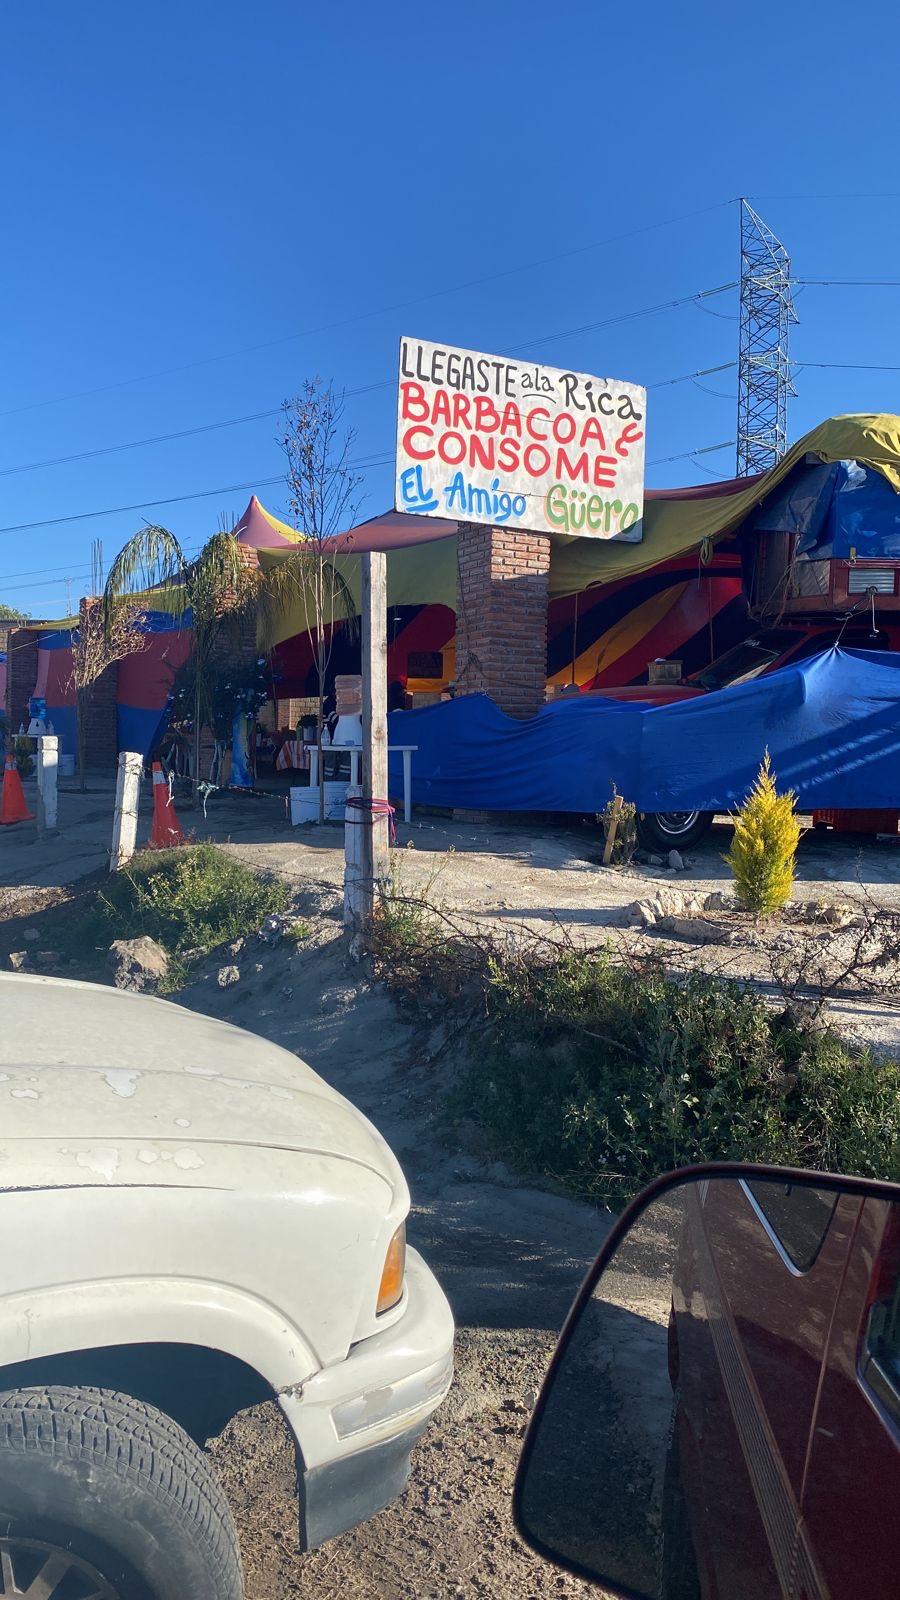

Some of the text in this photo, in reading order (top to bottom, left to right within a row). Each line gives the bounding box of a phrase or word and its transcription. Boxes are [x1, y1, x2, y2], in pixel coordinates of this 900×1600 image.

[402, 342, 518, 398] LLEGASTE
[558, 373, 643, 421] Rica
[400, 381, 606, 451] BARBACOA
[402, 425, 618, 488] CONSOME
[444, 471, 527, 522] Amigo
[546, 483, 639, 535] Güero
